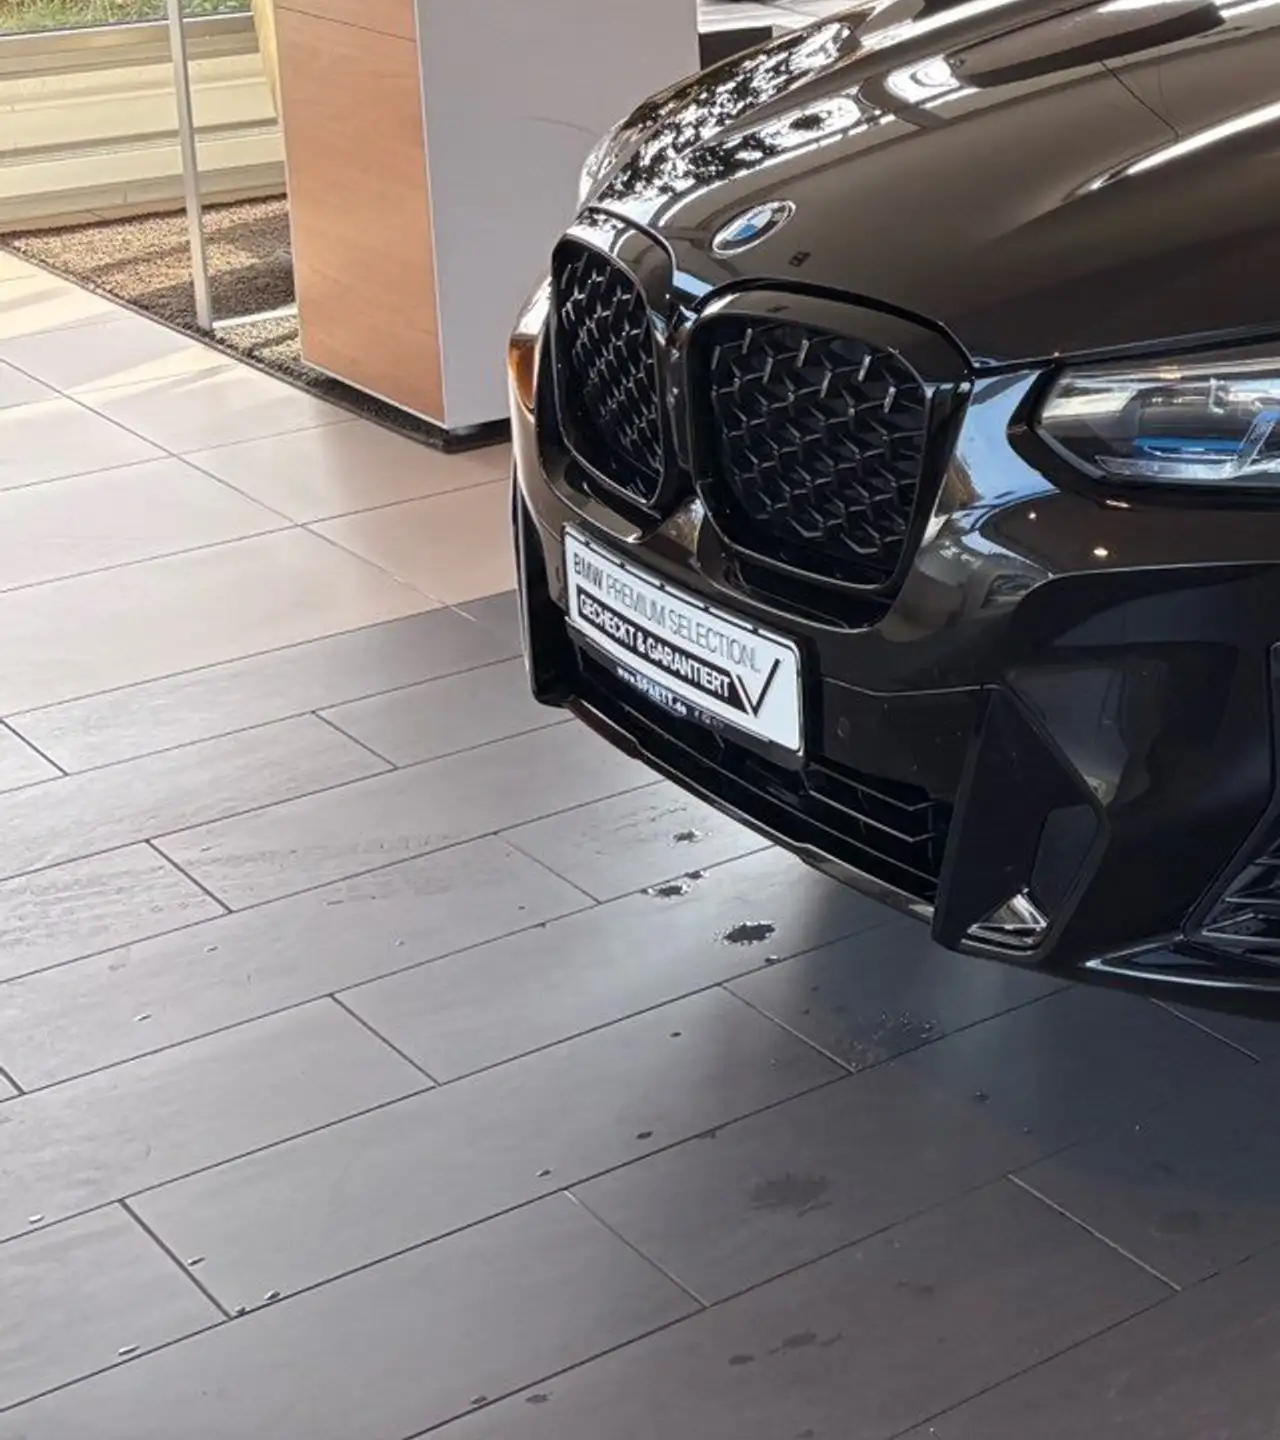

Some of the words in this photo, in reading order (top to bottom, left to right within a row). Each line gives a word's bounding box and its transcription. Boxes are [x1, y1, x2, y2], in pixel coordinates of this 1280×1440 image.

[574, 552, 604, 590] BMW
[606, 573, 667, 629] PREMIUM
[579, 593, 636, 647] GECHECKT
[636, 635, 647, 654] &
[648, 636, 732, 698] GARANTIERT
